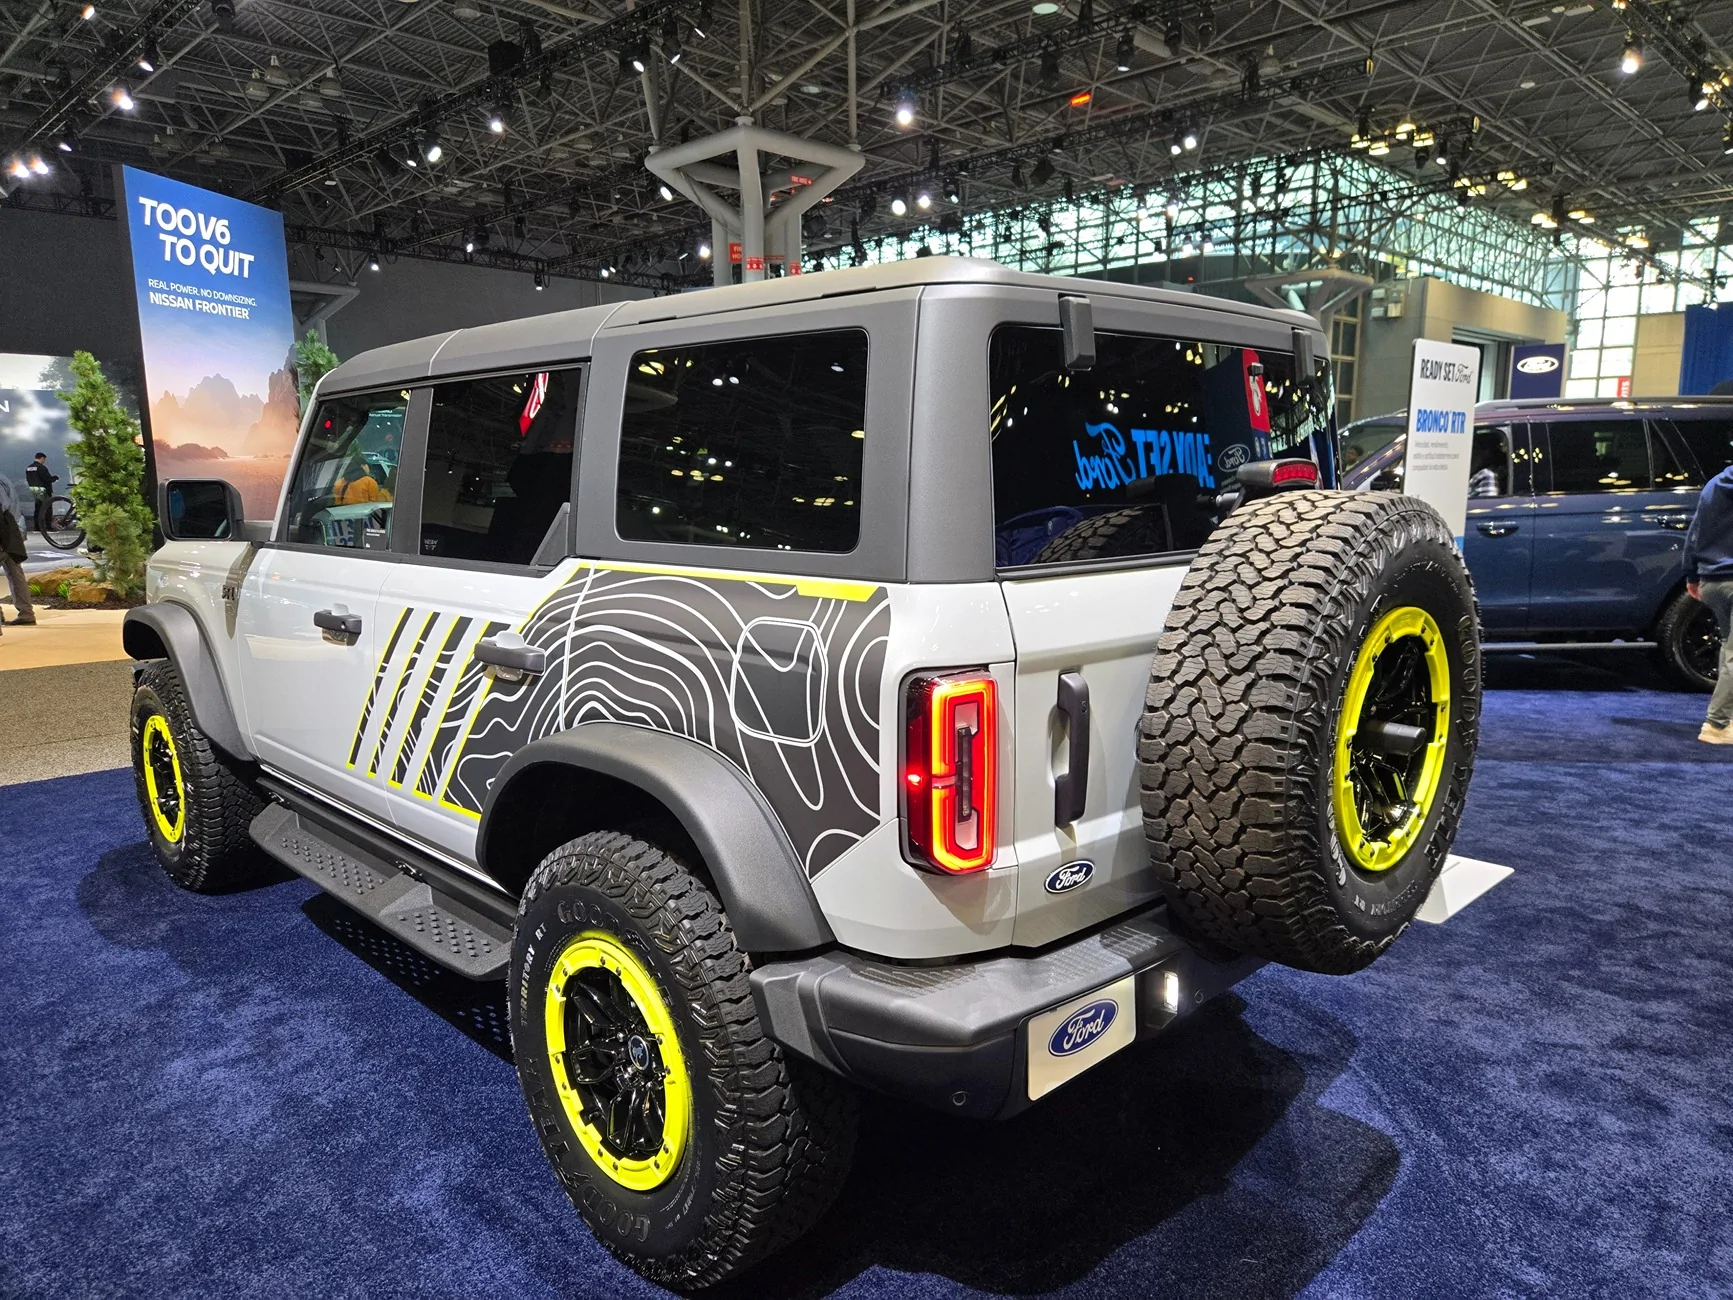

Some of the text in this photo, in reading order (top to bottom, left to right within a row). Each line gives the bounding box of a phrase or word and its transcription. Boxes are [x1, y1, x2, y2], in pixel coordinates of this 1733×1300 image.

[139, 196, 231, 245] TOO V6
[159, 233, 254, 279] TO QUIT
[148, 278, 257, 306] REAL POWER. NO DOWNSIZING.
[149, 291, 250, 320] NISSAN FRONTIER
[1420, 359, 1473, 384] READY SET Ford
[1416, 408, 1466, 434] BRONCO RTR
[1055, 865, 1086, 890] Ford
[1062, 1008, 1105, 1051] Ford
